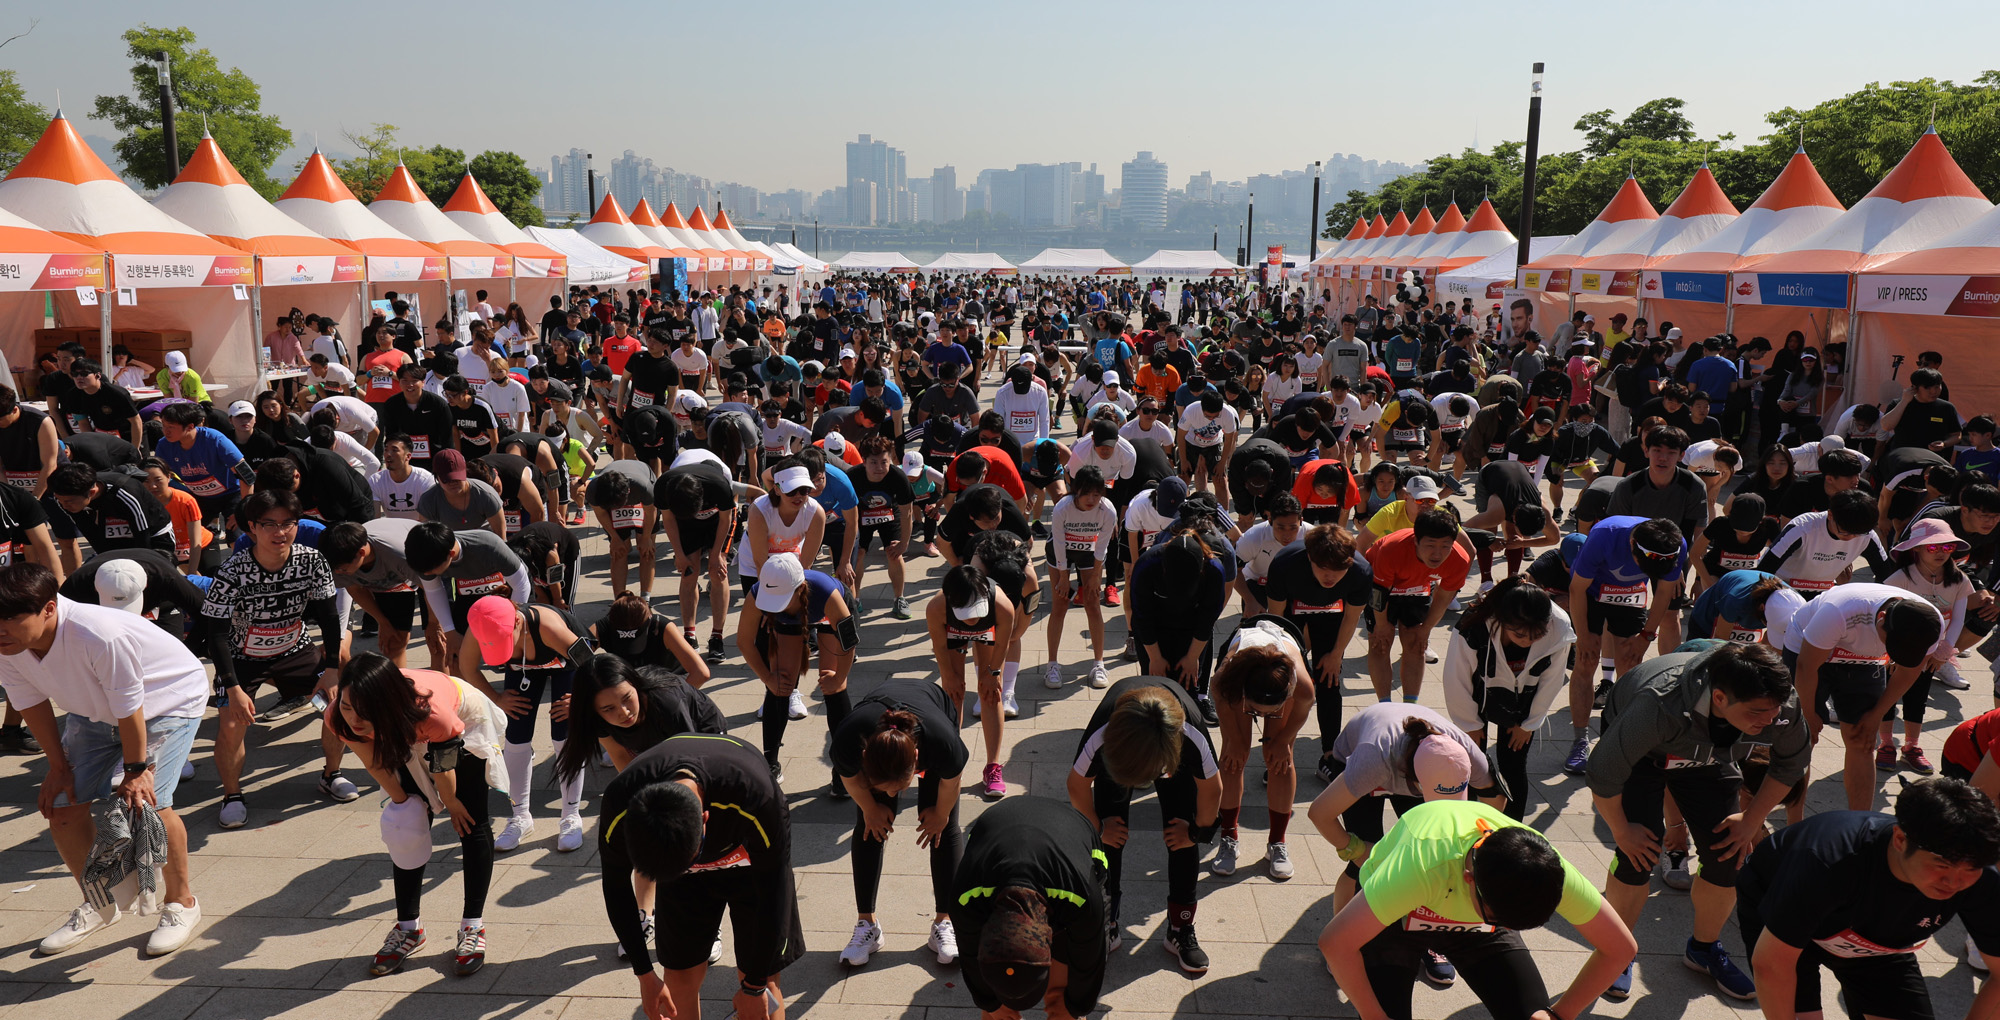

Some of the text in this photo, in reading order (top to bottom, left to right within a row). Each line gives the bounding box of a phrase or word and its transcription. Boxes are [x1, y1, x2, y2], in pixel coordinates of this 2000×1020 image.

[50, 267, 83, 278] Burning
[85, 266, 101, 275] Run
[127, 264, 194, 278] 진행본부/등록확인
[214, 267, 239, 275] Burning
[1877, 287, 1928, 302] VIP / PRESS
[1963, 290, 2000, 304] Burning
[648, 316, 666, 325] KOREA
[1101, 347, 1115, 355] ECO
[634, 395, 651, 405] 2630
[457, 419, 477, 427] FCMM
[1014, 417, 1033, 425] 2845
[9, 479, 37, 488] 2035
[192, 482, 216, 491] 2036
[615, 508, 641, 519] 3099
[1065, 542, 1092, 550] 2502
[1725, 560, 1754, 568] 2613
[459, 574, 500, 586] Burning Run
[1605, 594, 1640, 603] 3061
[252, 623, 299, 635] Burning Run
[253, 632, 294, 646] 2653
[1729, 631, 1756, 641] 060
